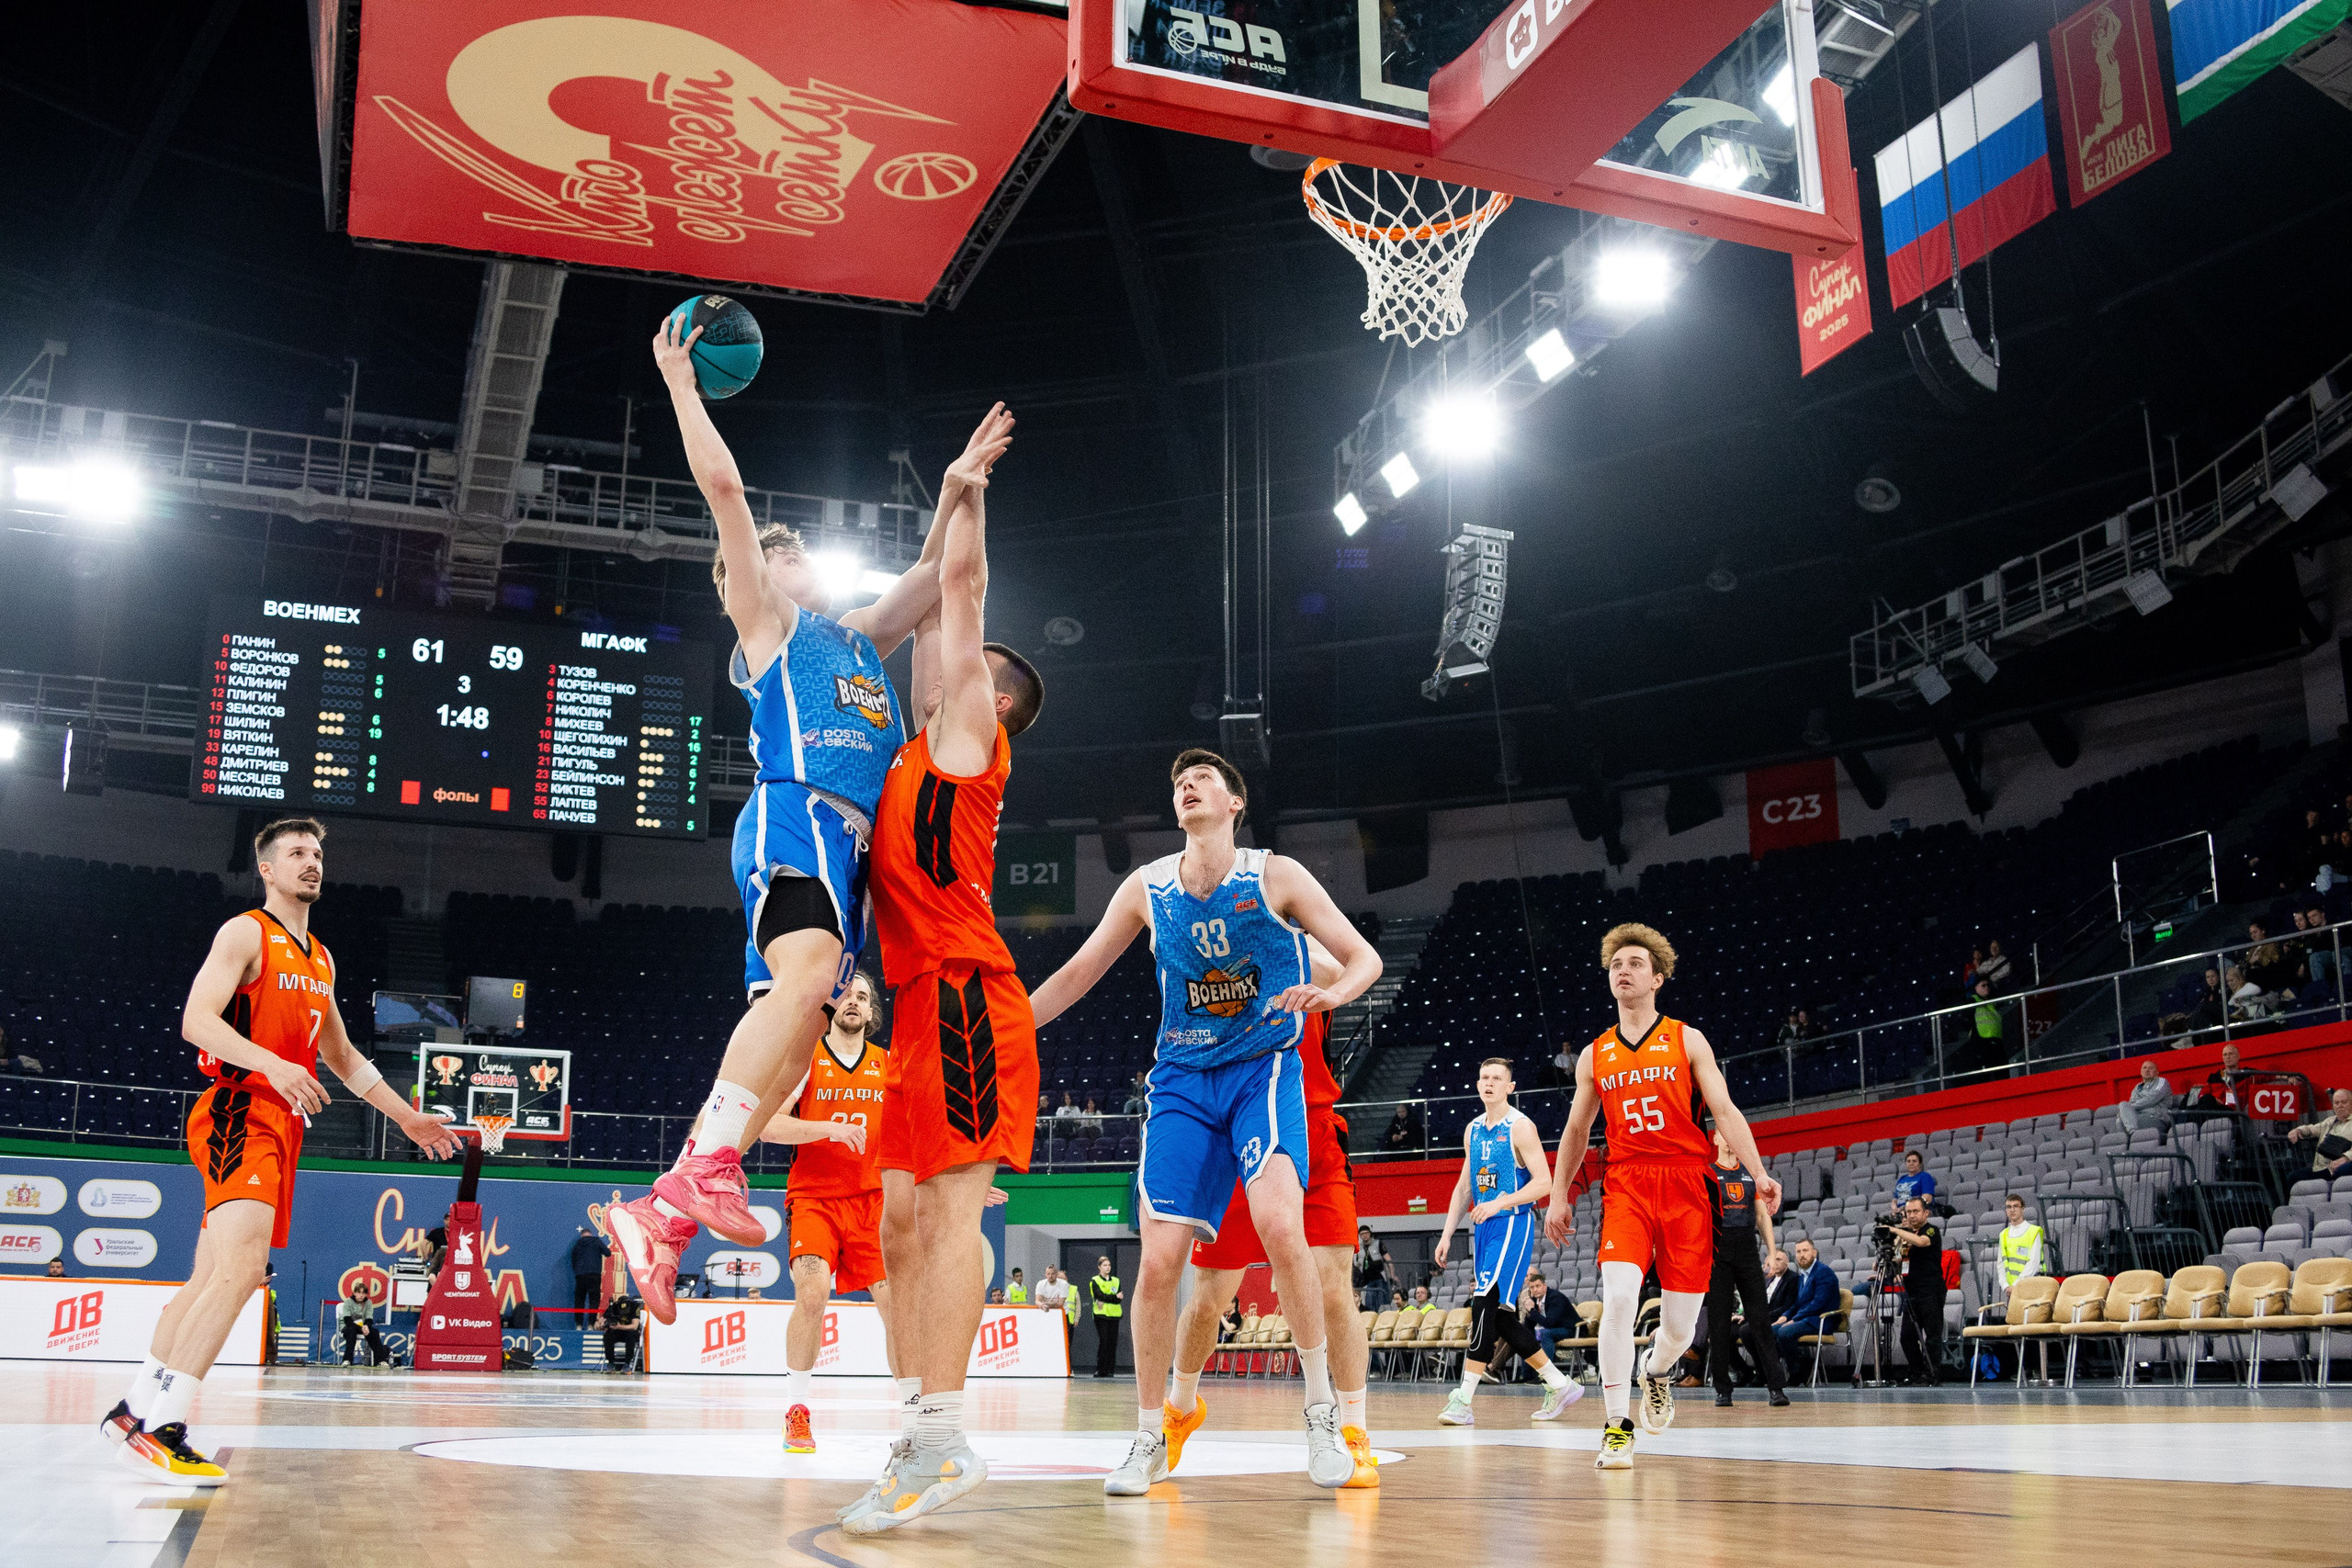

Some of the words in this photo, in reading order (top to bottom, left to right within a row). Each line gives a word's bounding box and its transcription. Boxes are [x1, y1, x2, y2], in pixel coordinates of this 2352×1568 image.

[2106, 123, 2148, 162] ЛИГА
[1803, 275, 1862, 328] ФИНАЛ
[1820, 313, 1849, 341] 2025
[263, 599, 361, 625] ВОЕНМЕХ
[222, 634, 230, 643] 0
[232, 635, 276, 649] ПАНИН
[378, 648, 386, 660] 5
[412, 637, 445, 663] 61
[489, 645, 524, 671] 59
[581, 632, 648, 653] МГАФК
[220, 649, 229, 658] 5
[231, 649, 300, 665] ВОРОНКОВ
[214, 660, 228, 671] 10
[230, 661, 291, 677] ФЕДОРОВ
[375, 674, 384, 686] 5
[548, 664, 556, 674] 3
[559, 665, 597, 679] ТУЗОВ
[211, 688, 225, 698] 12
[226, 689, 277, 704] ПЛИГИН
[214, 674, 227, 684] 11
[228, 675, 288, 690] КАЛИНИН
[374, 688, 383, 699] 6
[457, 675, 471, 694] 3
[548, 678, 555, 687] 4
[557, 678, 637, 695] КОРЕНЧЕНКО
[547, 691, 554, 700] 6
[556, 692, 612, 706] КОРОЛЕВ
[837, 678, 895, 726] ВОЕНМ
[209, 701, 223, 712] 15
[225, 702, 286, 717] ЗЕМСКОВ
[371, 715, 381, 726] 6
[436, 704, 490, 730] 1:48
[547, 704, 554, 713] 7
[556, 705, 612, 719] НИКОЛИЧ
[689, 716, 703, 727] 17
[207, 728, 221, 739] 19
[222, 729, 274, 744] ВЯТКИН
[209, 715, 221, 725] 17
[223, 716, 270, 730] ШИЛИН
[368, 728, 382, 739] 19
[545, 716, 552, 727] 8
[554, 717, 605, 731] МИХЕЕВ
[691, 729, 699, 739] 2
[539, 730, 551, 739] 10
[553, 731, 628, 747] ЩЕГОЛИХИН
[688, 742, 701, 753] 16
[205, 741, 220, 752] 33
[220, 743, 279, 758] КАРЕЛИН
[369, 755, 377, 766] 8
[537, 742, 550, 752] 16
[553, 744, 616, 759] ВАСИЛЬЕВ
[690, 755, 698, 766] 2
[204, 756, 218, 766] 48
[220, 757, 288, 773] ДМИТРИЕВ
[368, 768, 376, 779] 4
[537, 756, 550, 766] 21
[552, 757, 598, 771] ПИГУЛЬ
[689, 768, 697, 779] 6
[201, 783, 216, 794] 99
[218, 784, 285, 800] НИКОЛАЕВ
[202, 769, 217, 780] 50
[219, 771, 281, 785] МЕСЯЦЕВ
[367, 782, 375, 793] 8
[536, 769, 549, 779] 23
[551, 770, 625, 786] БЕЙЛИНСОН
[689, 781, 696, 792] 7
[433, 787, 480, 804] фолы
[534, 795, 548, 806] 55
[550, 796, 597, 810] ЛАПТЕВ
[535, 783, 548, 793] 52
[550, 784, 595, 797] КИКТЕВ
[687, 795, 695, 805] 4
[533, 809, 547, 819] 65
[549, 810, 597, 824] ПАЧУЕВ
[687, 820, 695, 831] 5
[1191, 918, 1231, 958] 33
[513, 983, 524, 998] 8
[1189, 974, 1258, 1008] ВОЕНМЕХ
[311, 1009, 322, 1048] 7
[470, 1073, 518, 1087] ФИНАЛ
[1600, 1066, 1677, 1092] МГАФК
[816, 1088, 884, 1102] МГАФК
[2254, 1090, 2295, 1114] C12
[1622, 1095, 1665, 1134] 55
[1480, 1140, 1493, 1161] 15
[48, 1291, 104, 1338] ДВ
[448, 1318, 461, 1327] VK
[463, 1318, 492, 1328] Видео
[46, 1327, 101, 1349] ДВИЖЕНИЕ
[701, 1310, 746, 1354] ДВ
[978, 1314, 1019, 1358] ДВ
[68, 1338, 100, 1353] ВВЕРХ
[701, 1344, 746, 1364] ДВИЖЕНИЕ
[719, 1353, 746, 1367] ВВЕРХ
[978, 1348, 1020, 1367] ДВИЖЕНИЕ
[996, 1357, 1020, 1371] ВВЕРХ
